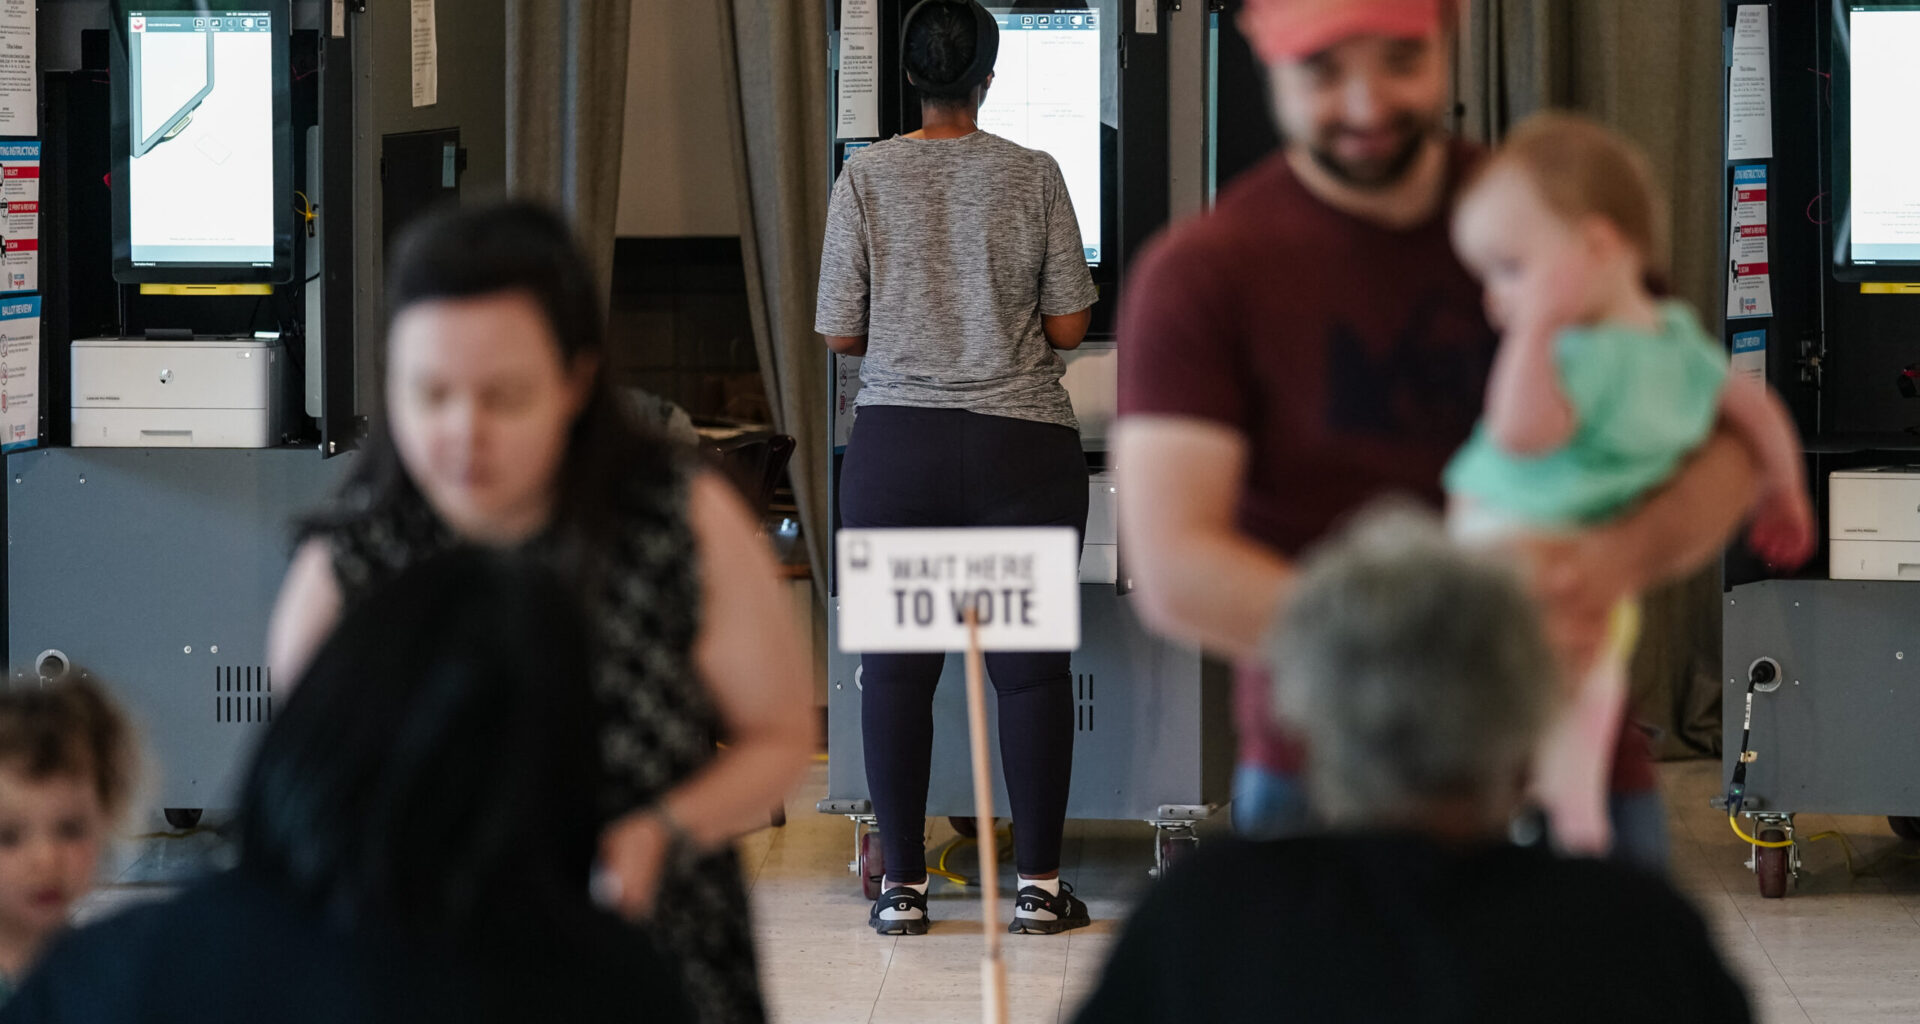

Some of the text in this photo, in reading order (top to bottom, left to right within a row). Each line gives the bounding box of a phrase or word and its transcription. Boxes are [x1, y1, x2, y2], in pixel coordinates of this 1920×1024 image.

[10, 146, 39, 156] INSTRUCTIONS
[16, 303, 33, 314] REVIEW
[889, 554, 1034, 580] WAIT HERE
[894, 588, 1036, 626] TO VOTE
